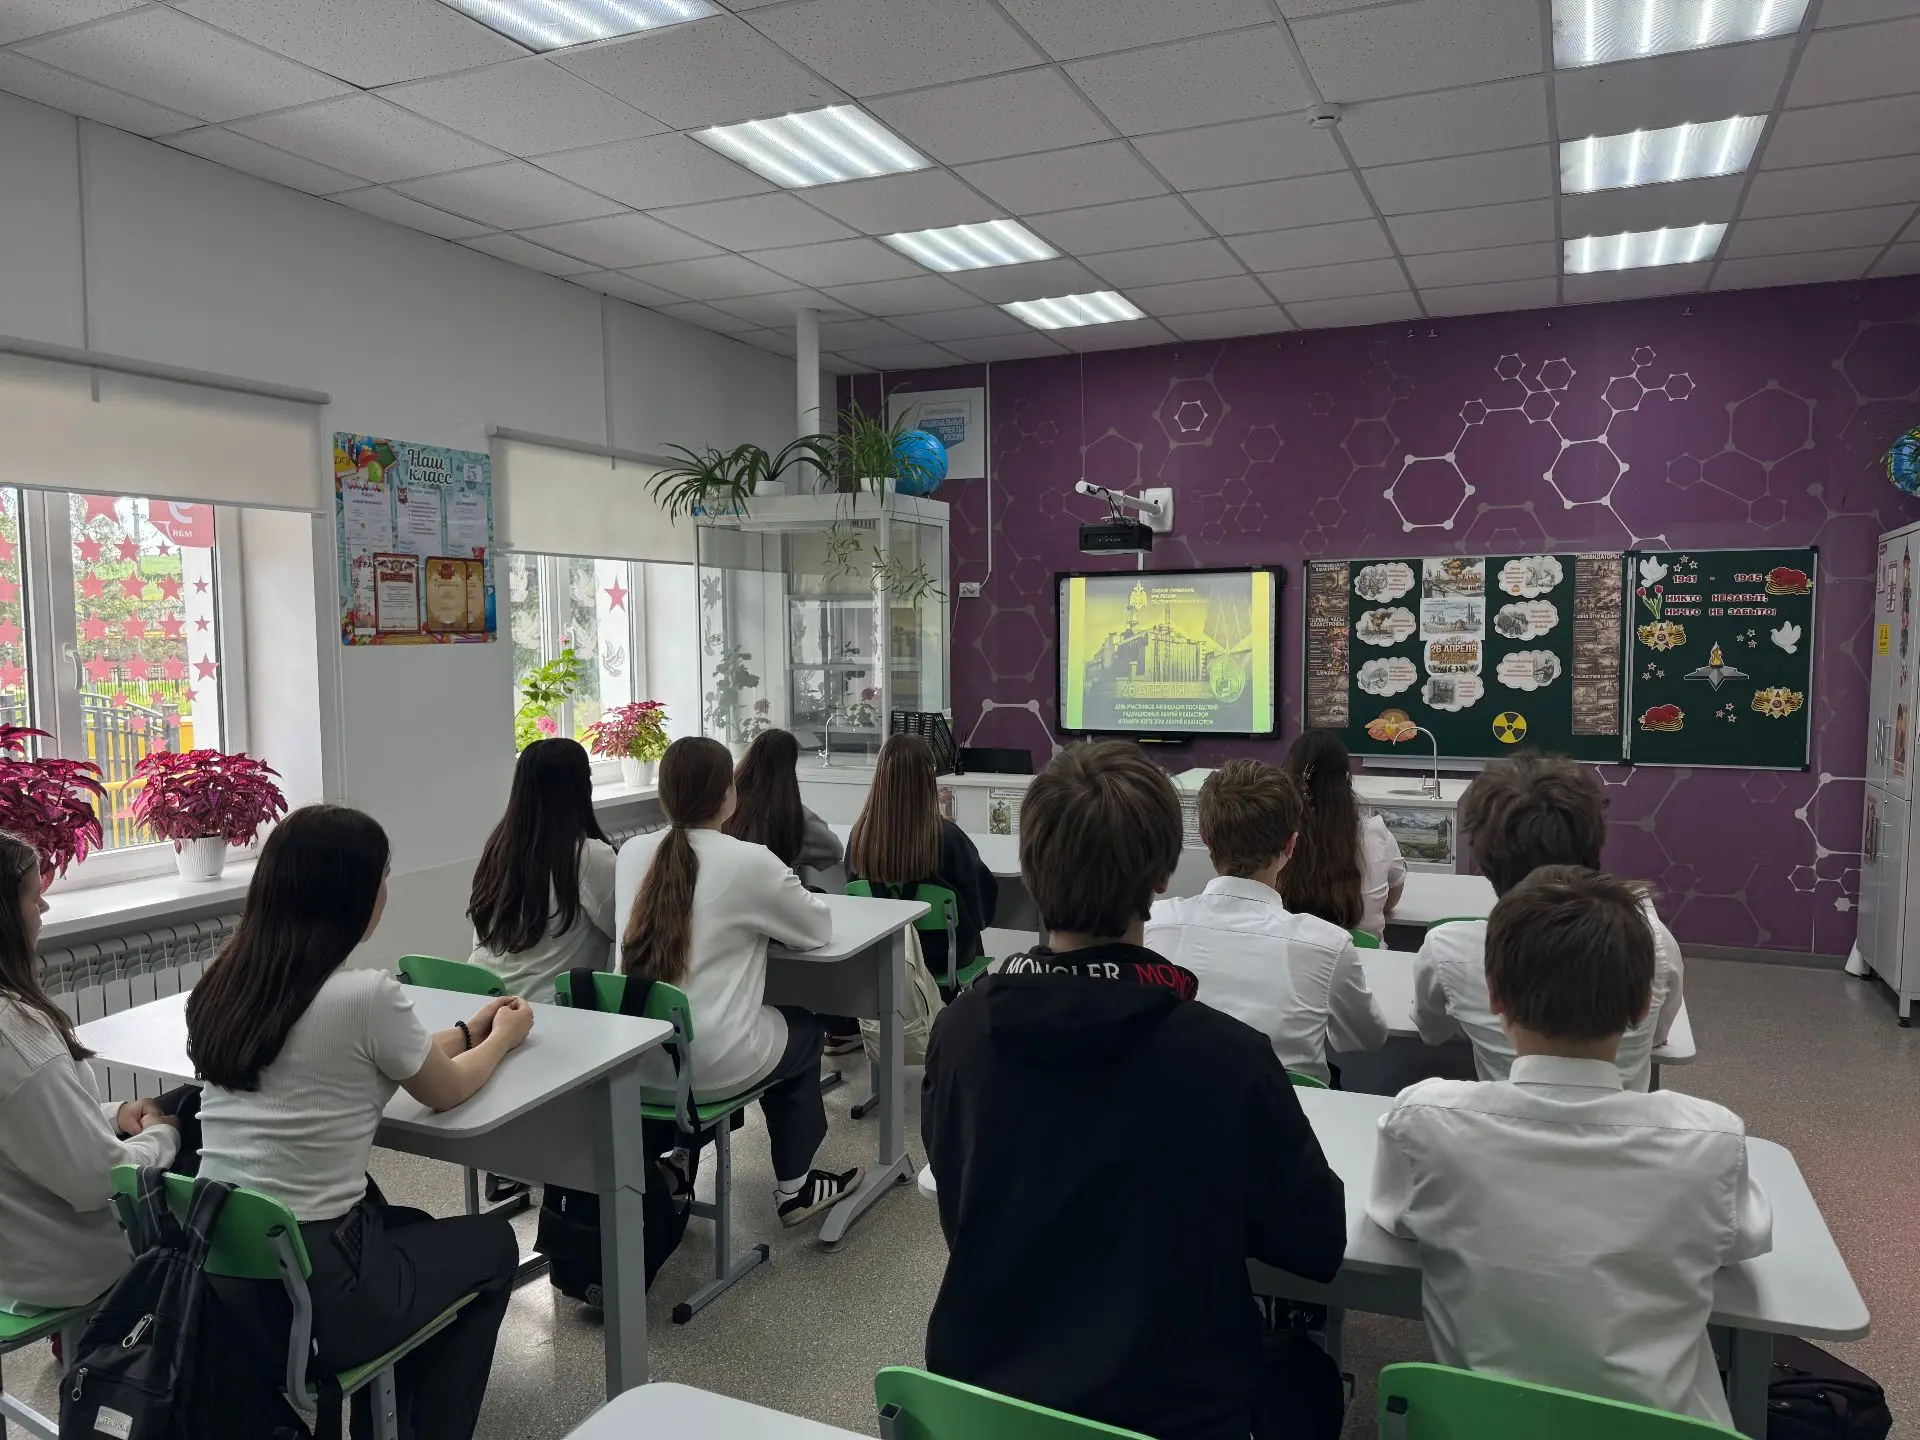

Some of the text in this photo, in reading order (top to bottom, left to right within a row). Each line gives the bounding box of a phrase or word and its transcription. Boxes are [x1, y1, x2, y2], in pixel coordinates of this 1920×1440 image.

[408, 449, 446, 470] Наш
[409, 468, 453, 485] класс
[1672, 574, 1698, 584] 1941
[1733, 573, 1763, 583] 1945
[1665, 594, 1702, 603] НИКТО
[1664, 607, 1777, 616] НИЧТО НЕ ЗАБЫТО!
[1444, 644, 1477, 653] АПРЕЛЯ
[1122, 682, 1185, 698] 26 АПРЕЛЯ
